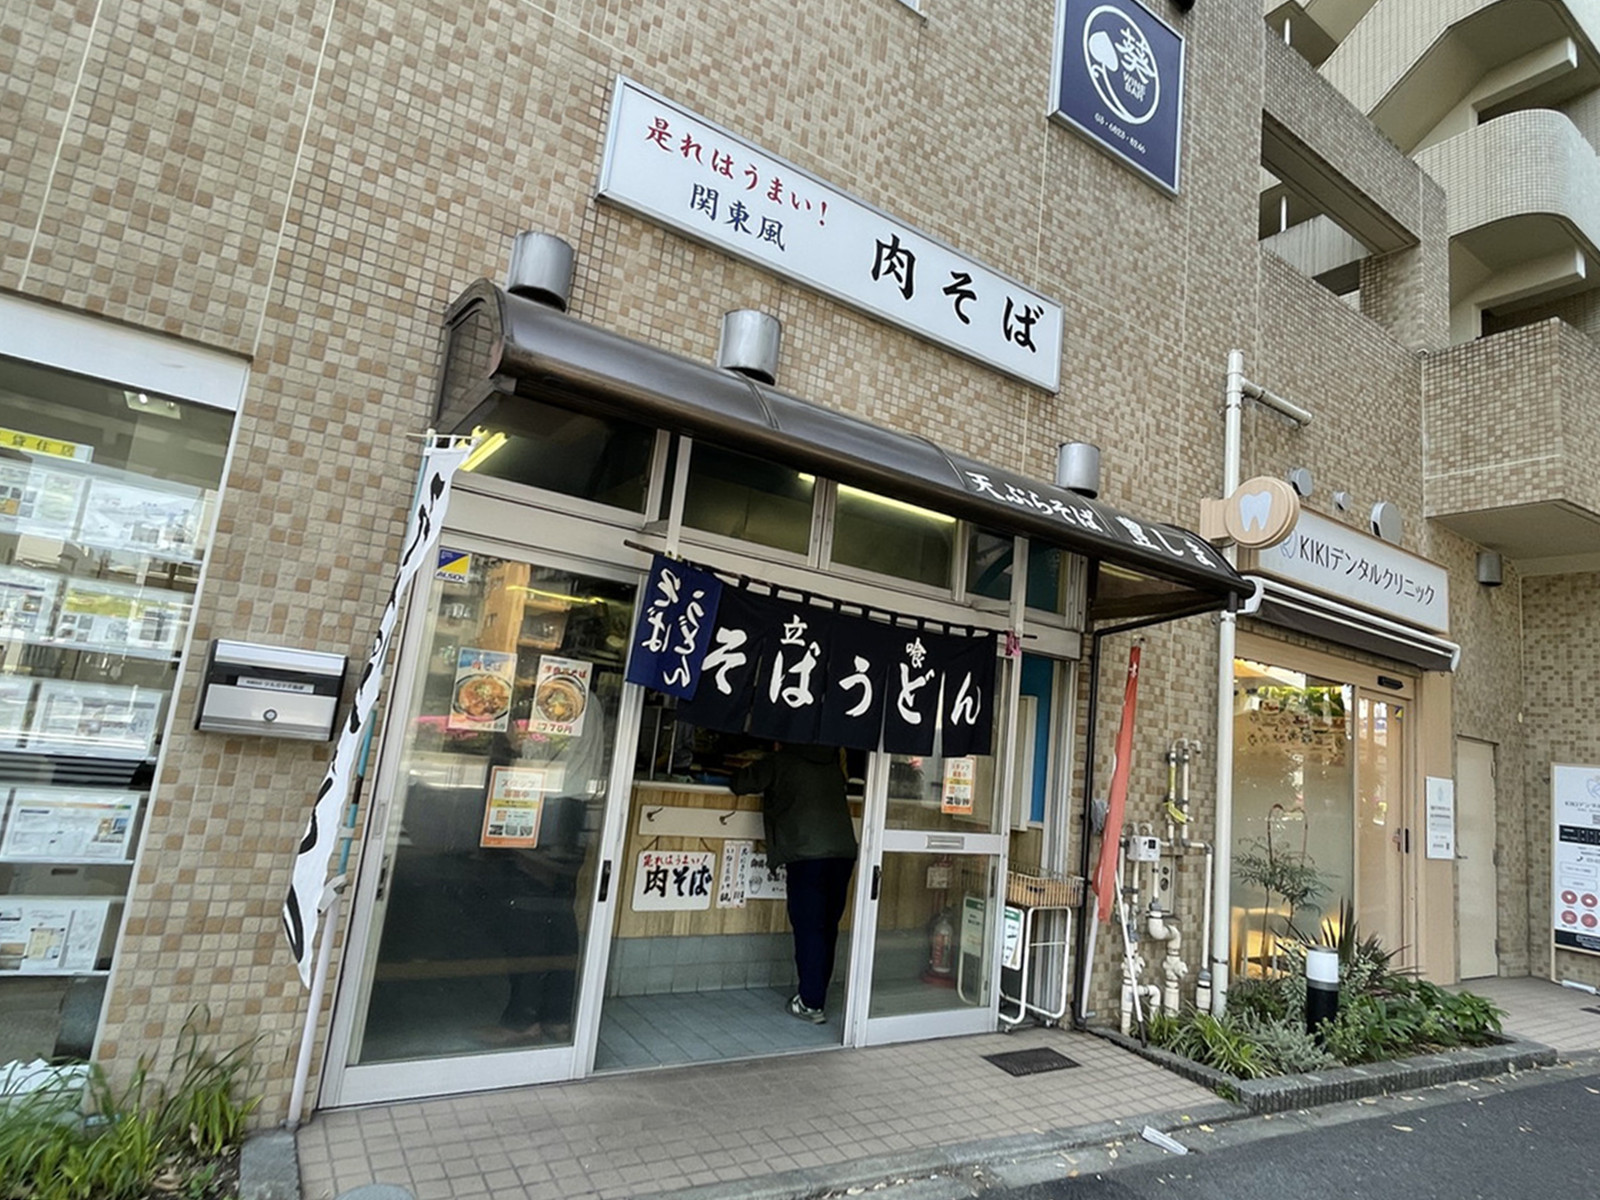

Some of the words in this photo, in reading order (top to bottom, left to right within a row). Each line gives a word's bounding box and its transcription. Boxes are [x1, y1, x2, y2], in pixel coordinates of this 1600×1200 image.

[645, 116, 829, 226] 是れはうまい!
[690, 183, 786, 252] 関東風
[871, 233, 1045, 353] 肉そば
[966, 470, 1103, 533] 天ぷらそば
[1300, 535, 1435, 605] KIKIデンタルクリニック
[780, 614, 808, 646] 立
[702, 627, 981, 726] そばうどん
[643, 865, 713, 897] 肉そば
